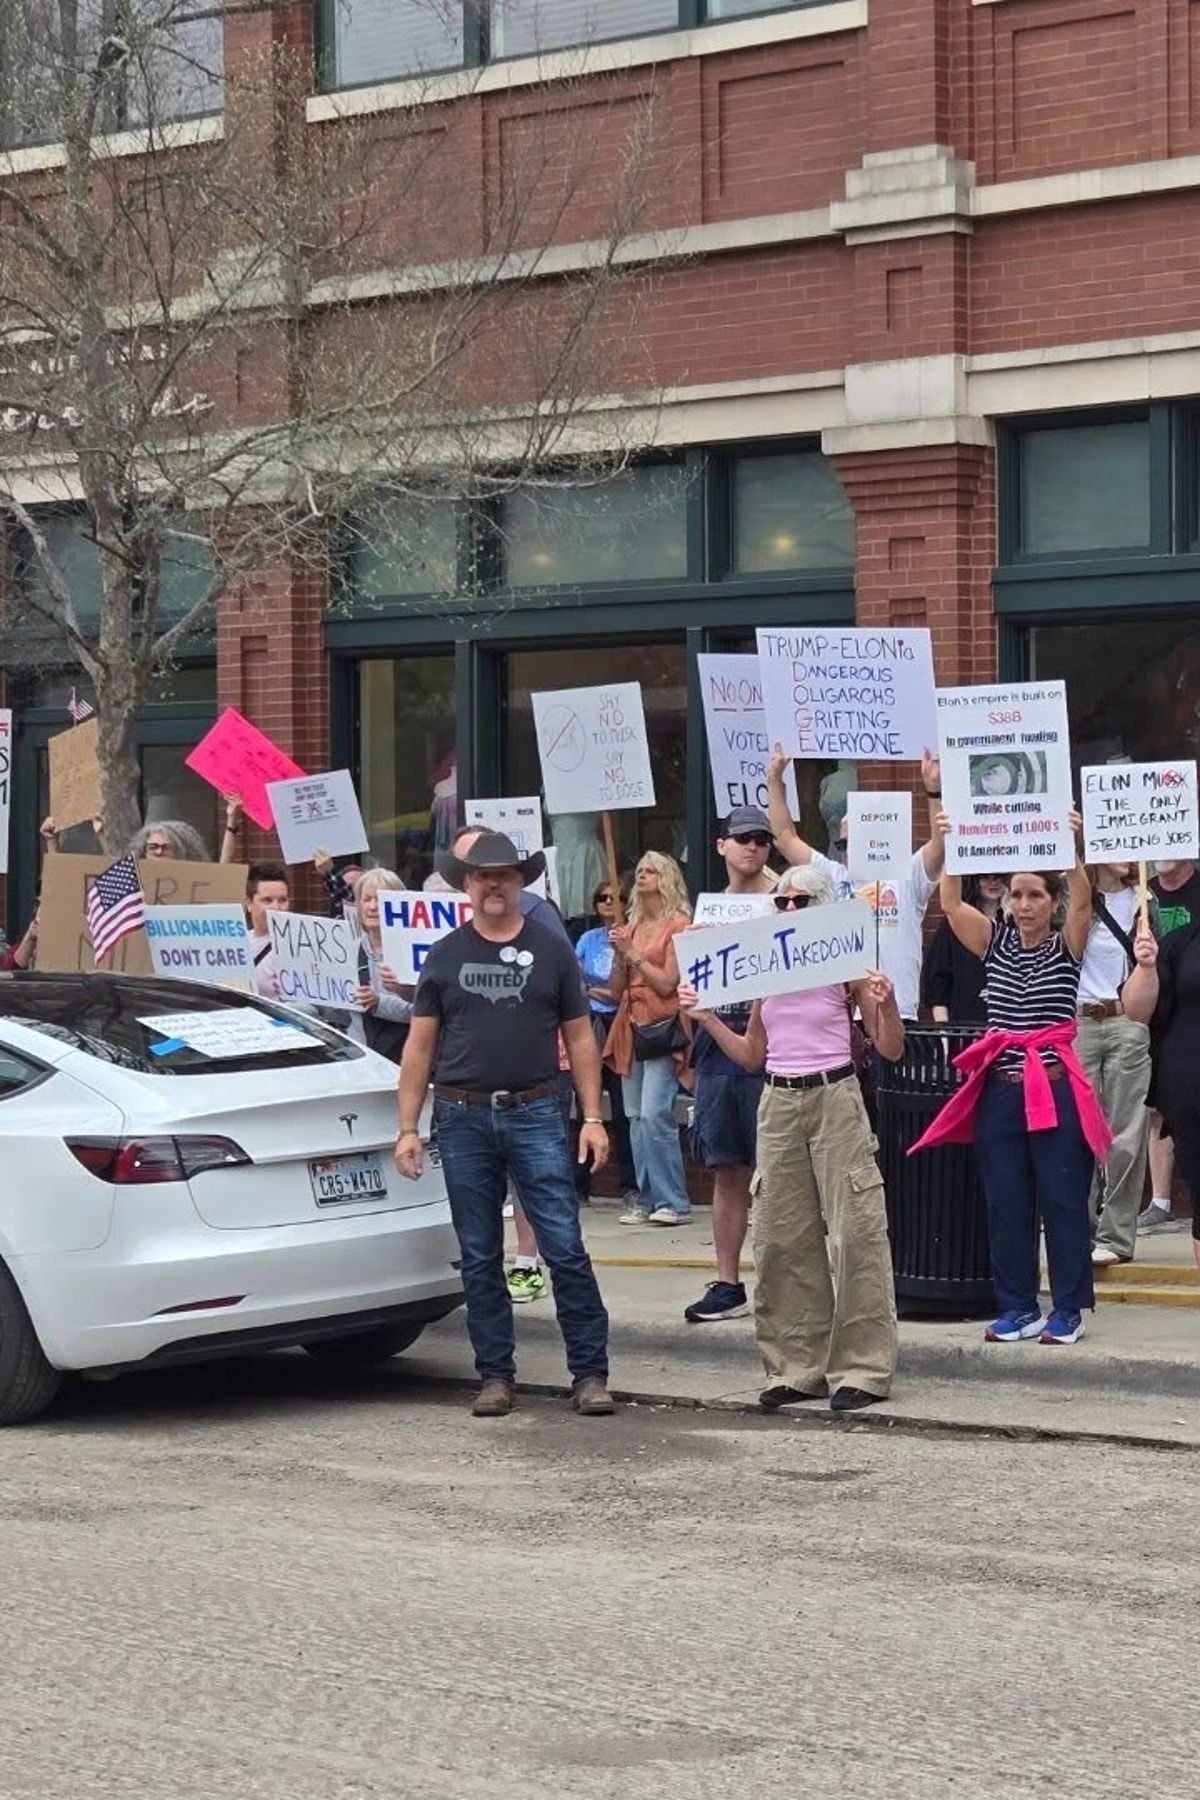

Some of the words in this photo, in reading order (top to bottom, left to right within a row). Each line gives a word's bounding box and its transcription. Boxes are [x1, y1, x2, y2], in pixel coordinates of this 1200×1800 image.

[792, 661, 893, 684] DANGEROUS
[793, 684, 896, 706] OLIGARCHS
[794, 707, 891, 730] GRIFTING
[723, 728, 769, 752] VOTE
[799, 729, 904, 755] EVERYONE
[727, 783, 769, 808] ELO
[1150, 795, 1182, 809] ONLY
[861, 813, 899, 823] DEPORT
[1095, 809, 1190, 829] IMMIGRANT
[1089, 834, 1161, 852] STEALING
[384, 900, 474, 929] HAND
[146, 919, 247, 939] BILLIONAIRES
[271, 916, 348, 964] MARS
[205, 947, 247, 967] CARE
[279, 969, 357, 1004] CALLING
[464, 973, 524, 987] UNITED
